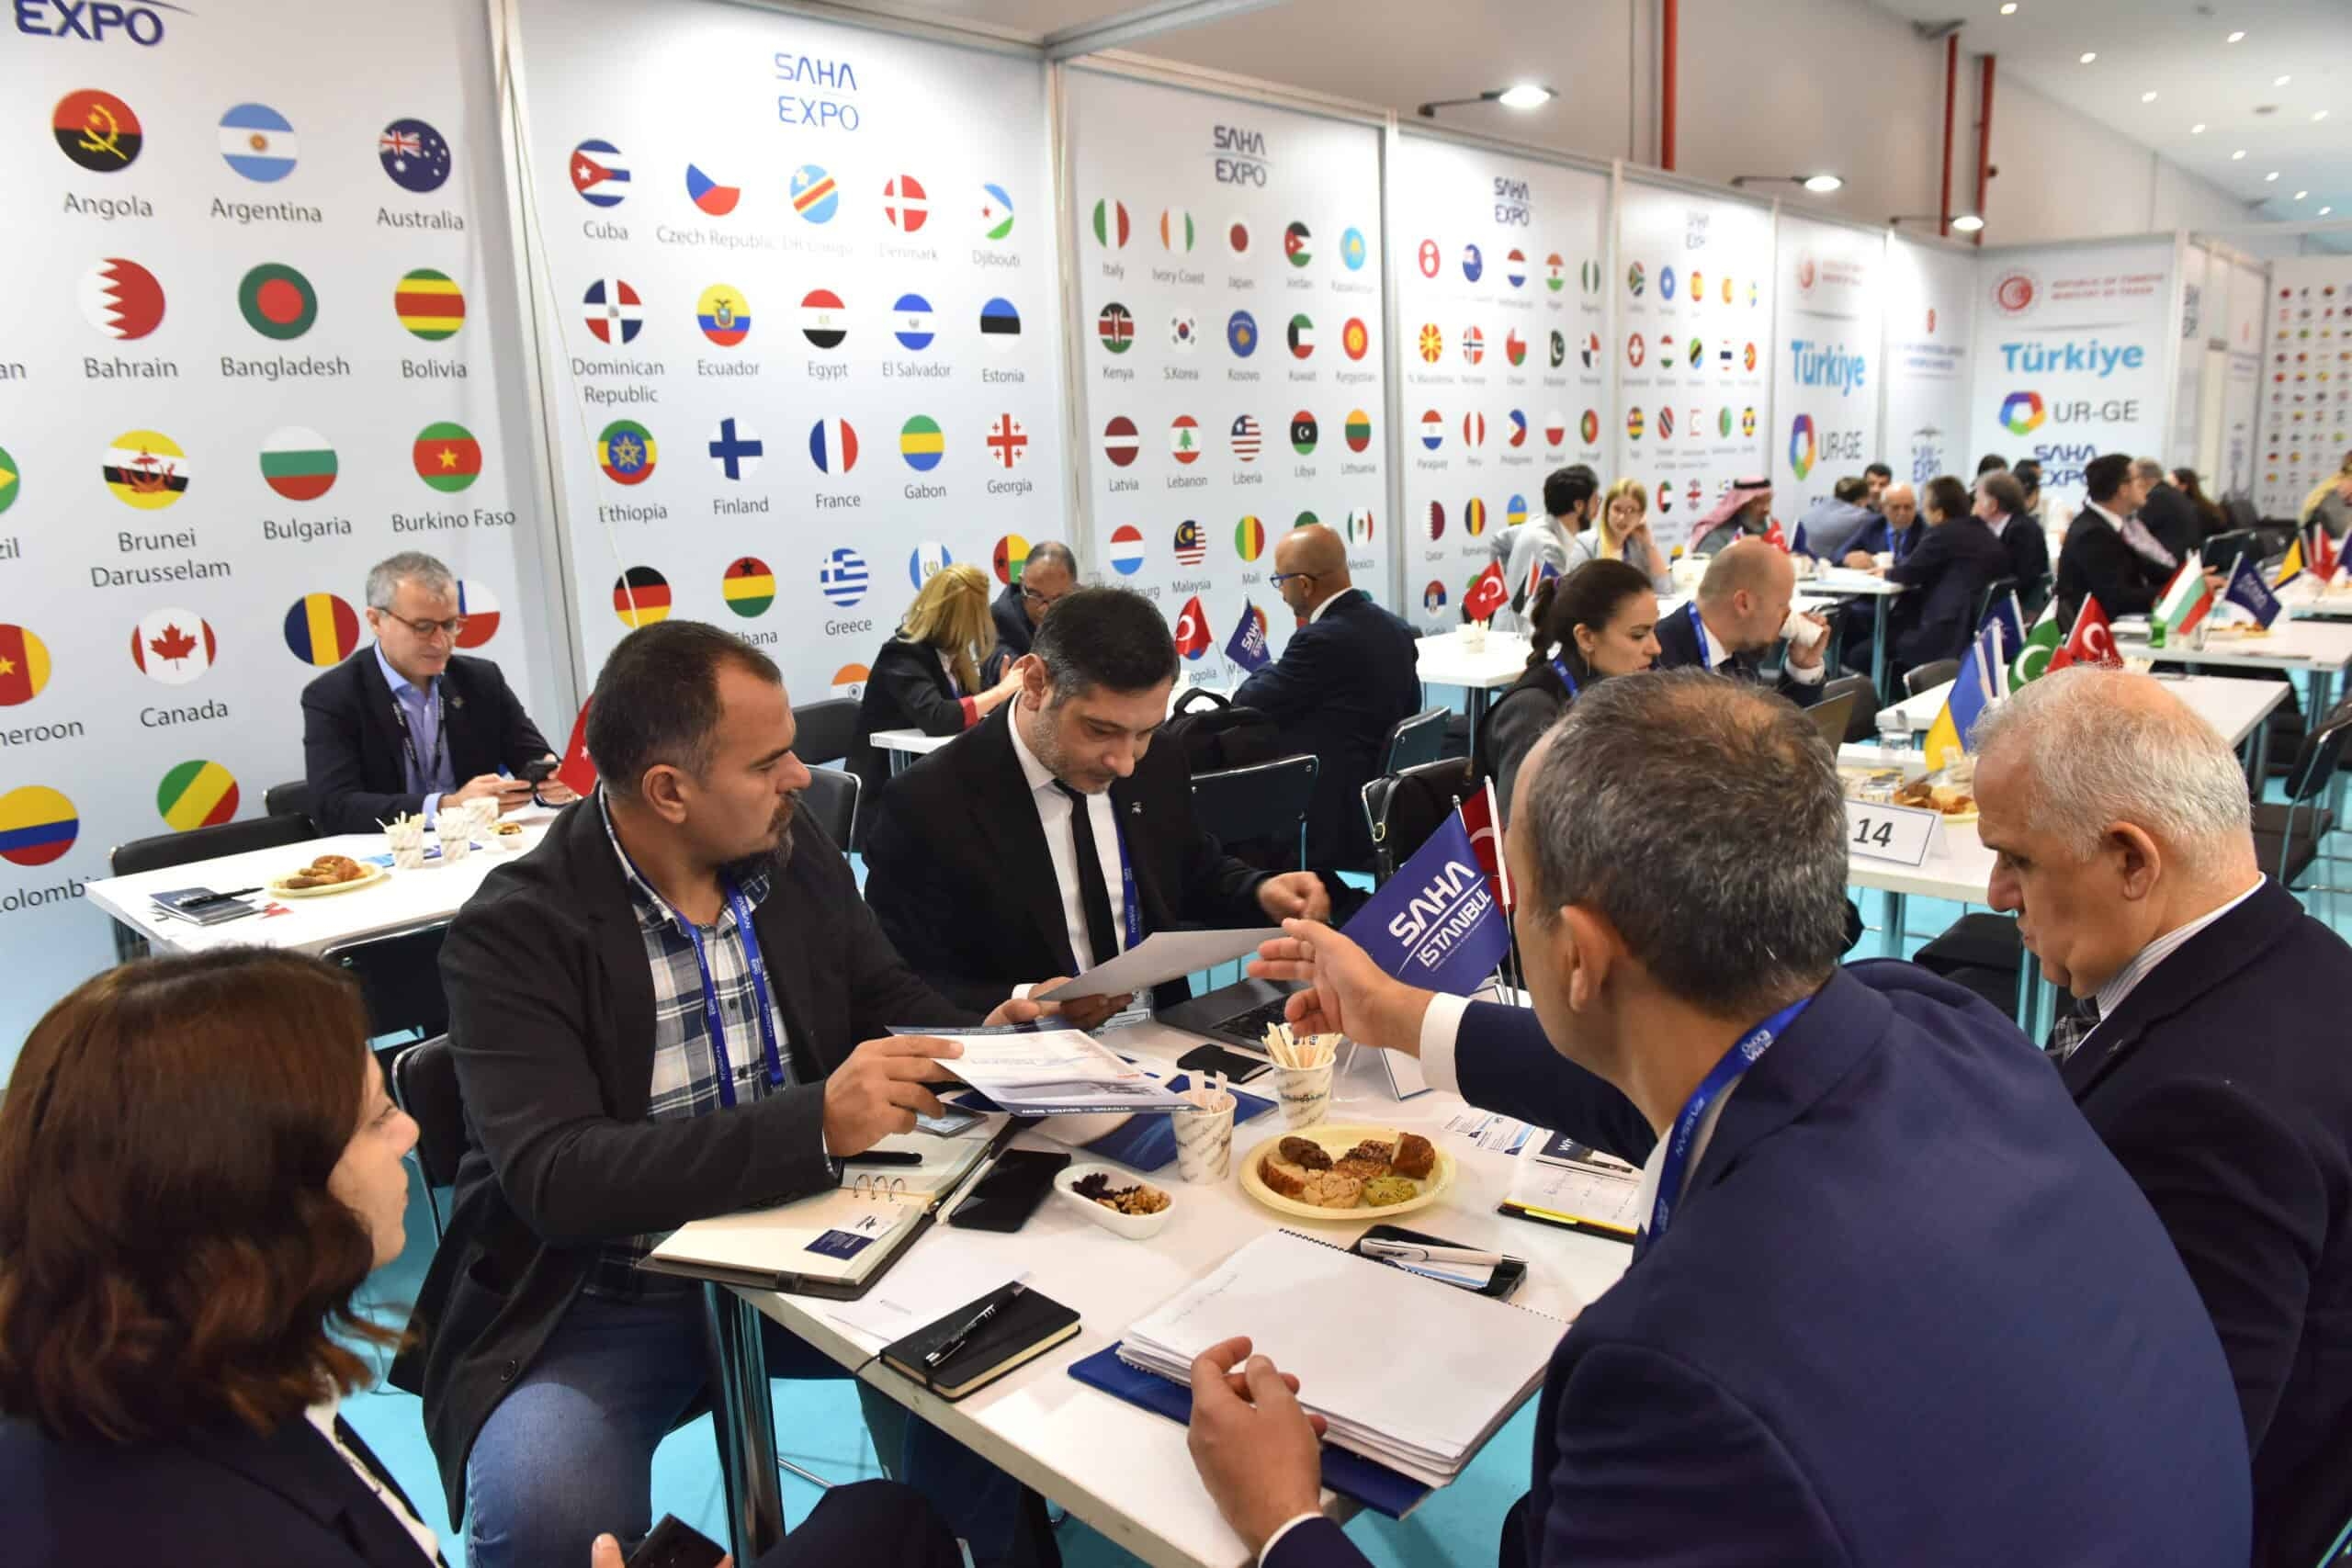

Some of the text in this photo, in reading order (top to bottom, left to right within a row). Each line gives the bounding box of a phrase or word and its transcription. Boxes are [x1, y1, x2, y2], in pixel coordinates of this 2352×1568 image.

[13, 0, 165, 46] EXPO
[775, 53, 857, 91] SAHA
[778, 96, 859, 130] EXPO
[1213, 126, 1266, 154] SAHA
[1215, 159, 1267, 187] EXPO
[1494, 176, 1528, 200] SAHA
[64, 192, 153, 220] Angola
[210, 197, 322, 224] Argentina
[1495, 204, 1529, 227] EXPO
[377, 207, 464, 230] Australia
[583, 220, 628, 241] Cuba
[656, 225, 705, 244] Czech
[973, 250, 1022, 268] Djibouti
[1102, 263, 1125, 281] Italy
[1152, 268, 1205, 285] Ivory Coast
[1228, 276, 1254, 291] Japan
[84, 357, 178, 378] Bahrain
[220, 355, 350, 381] Bangladesh
[401, 359, 468, 378] Bolivia
[571, 357, 664, 376] Dominican
[698, 360, 759, 376] Ecuador
[1792, 340, 1865, 397] Türkiye
[2000, 339, 2145, 378] Türkiye
[808, 361, 848, 380] Egypt
[882, 361, 950, 378] El Salvador
[982, 368, 1024, 382] Estonia
[1102, 367, 1135, 382] Kenya
[1227, 368, 1261, 382] Kosovo
[584, 385, 658, 407] Republic
[2054, 400, 2140, 423] UR-GE
[2034, 444, 2098, 462] SAHA
[987, 479, 1033, 496] Georgia
[1110, 478, 1139, 492] Latvia
[1167, 475, 1207, 489] Lebanon
[1233, 472, 1262, 485] Liberia
[816, 493, 860, 508] France
[904, 484, 946, 500] Gabon
[713, 496, 769, 514] Finland
[264, 517, 351, 542] Bulgaria
[392, 509, 516, 532] Burkino Faso
[118, 528, 196, 552] Brunei
[91, 558, 231, 587] Darusselam
[1172, 581, 1211, 594] Malaysia
[825, 619, 872, 636] Greece
[141, 700, 228, 728] Canada
[1852, 818, 1894, 848] 14
[0, 878, 102, 914] olomb
[1388, 860, 1476, 947] SAHA
